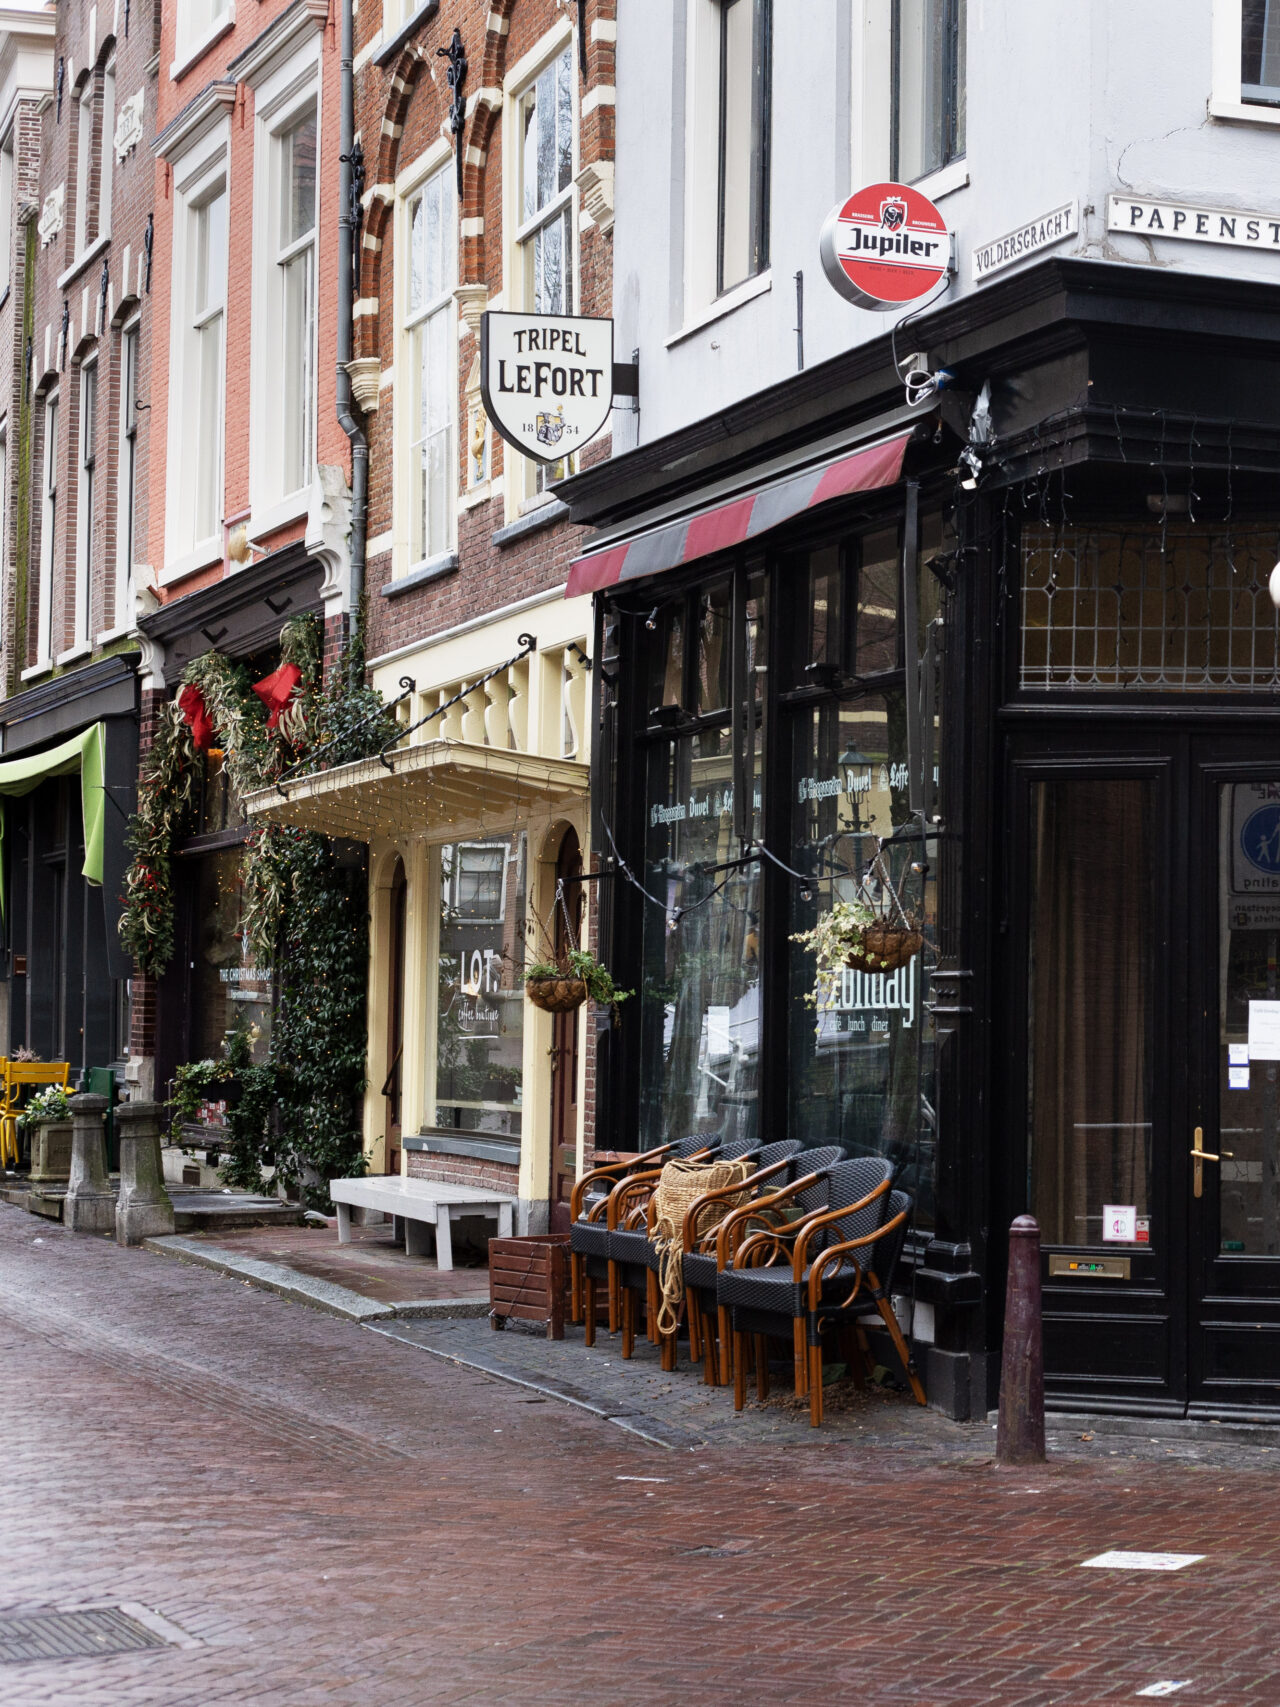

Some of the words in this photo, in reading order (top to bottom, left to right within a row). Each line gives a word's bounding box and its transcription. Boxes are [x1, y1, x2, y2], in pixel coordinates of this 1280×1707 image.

[847, 227, 939, 257] Jupiler
[976, 209, 1072, 272] VOLDERSGRACHT
[513, 328, 587, 357] TRIPEL
[522, 423, 534, 433] 18
[219, 968, 229, 982] THE
[229, 966, 257, 982] CHRISTMAS
[847, 1015, 866, 1032] lunch
[871, 1015, 888, 1032] diner
